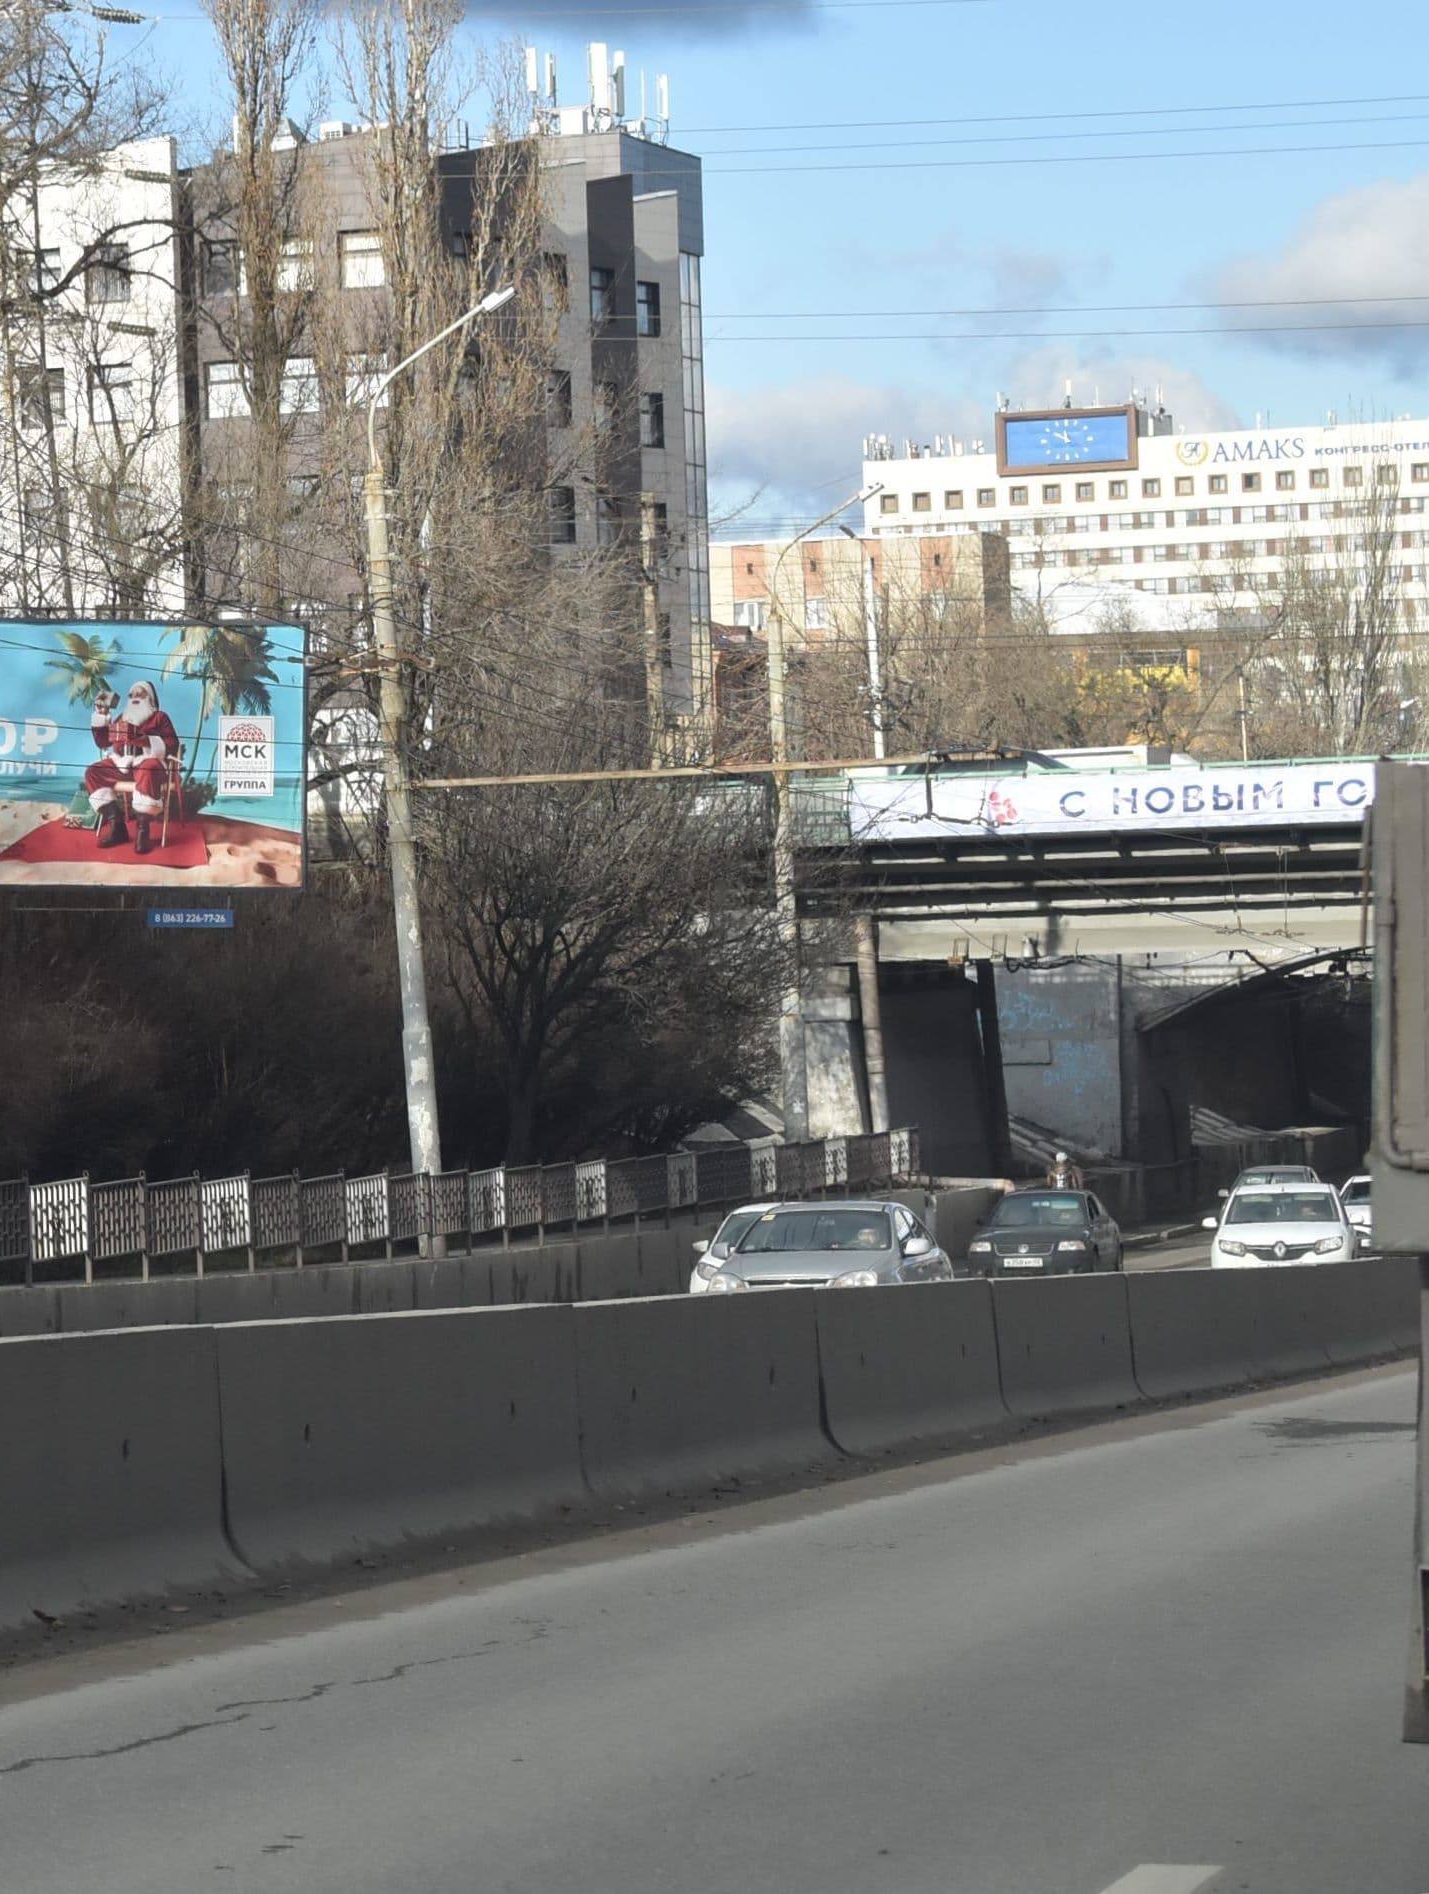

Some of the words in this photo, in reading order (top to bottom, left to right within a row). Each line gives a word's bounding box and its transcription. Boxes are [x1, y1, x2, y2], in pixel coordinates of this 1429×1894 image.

[1212, 437, 1306, 463] AMAKS
[224, 744, 266, 759] МСК
[224, 780, 266, 789] ГРУППА
[1059, 791, 1086, 818] С
[1113, 780, 1284, 815] НОВЫМ
[1314, 778, 1367, 808] ГО
[154, 913, 161, 923] 8
